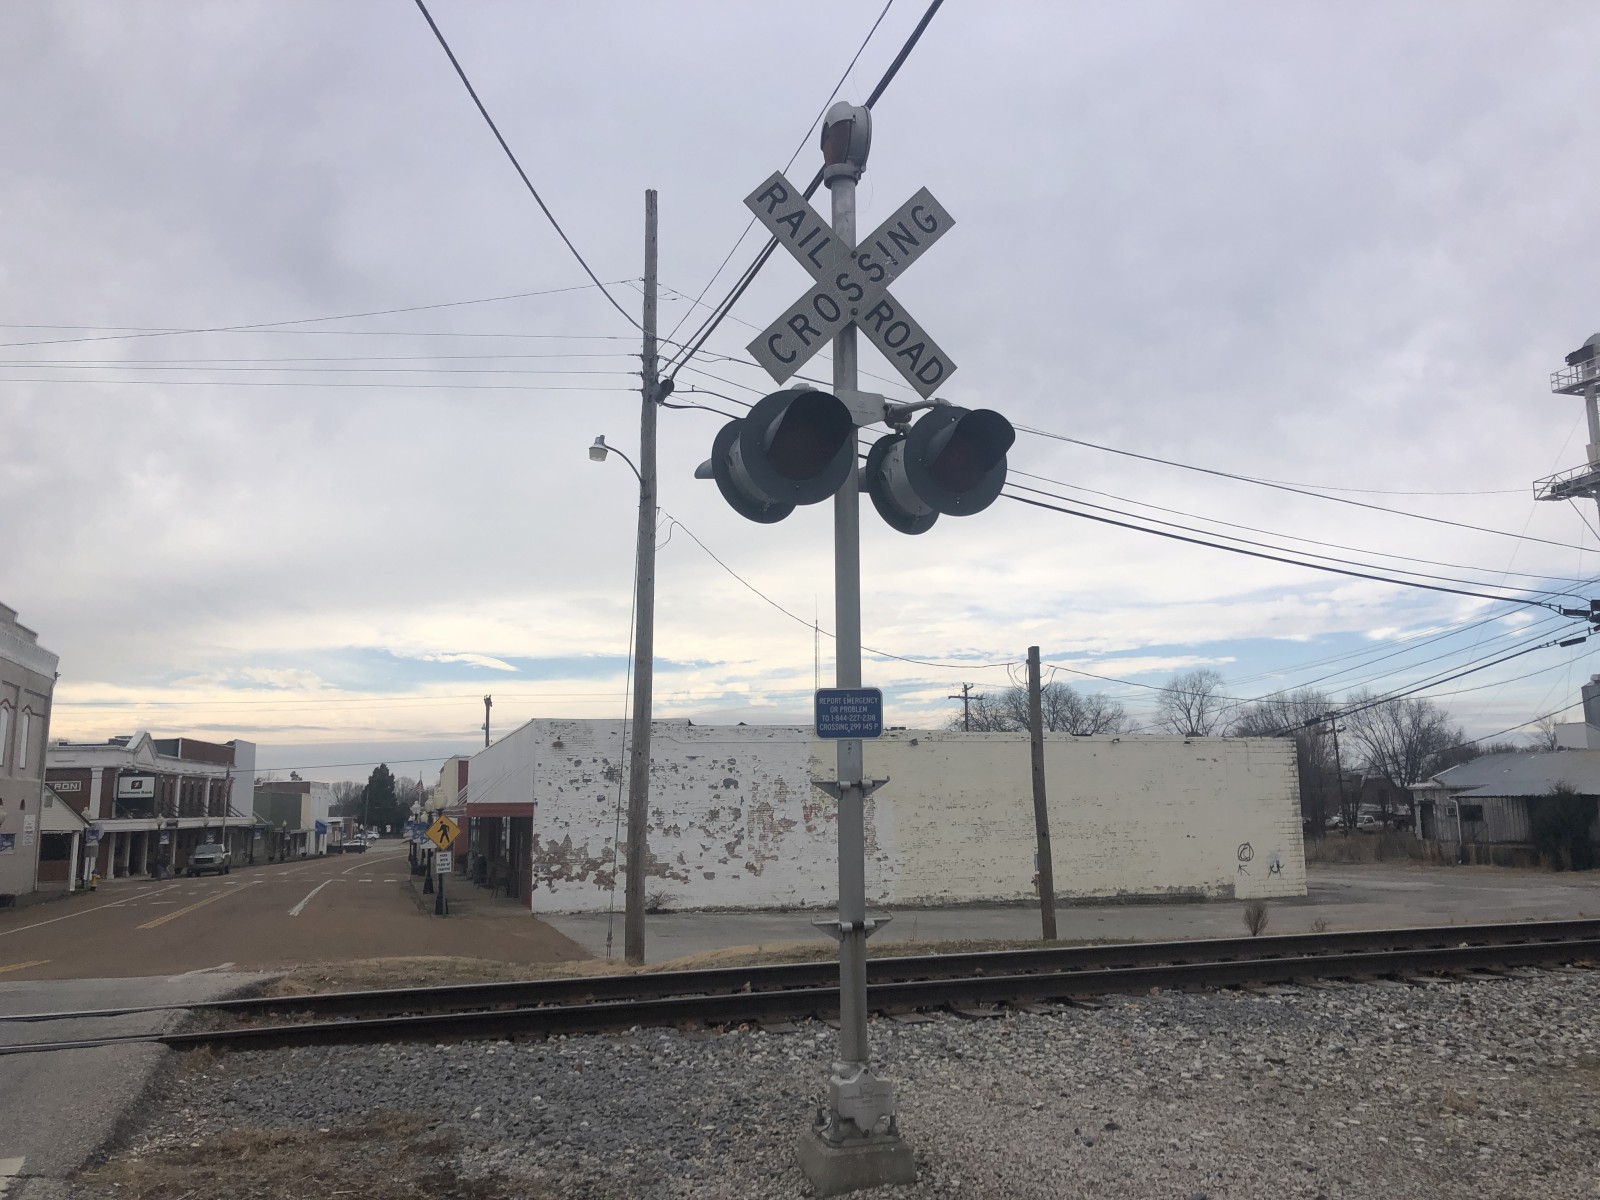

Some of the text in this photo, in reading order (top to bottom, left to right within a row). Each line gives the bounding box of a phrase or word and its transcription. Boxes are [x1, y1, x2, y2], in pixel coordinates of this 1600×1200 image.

[756, 181, 831, 270] RAIL
[767, 205, 938, 364] CROSSING
[864, 299, 944, 385] ROAD
[819, 697, 841, 705] REPORT
[839, 705, 868, 713] PROBLEM
[822, 714, 830, 722] TO
[819, 723, 849, 731] CROSSING
[863, 723, 872, 731] 145
